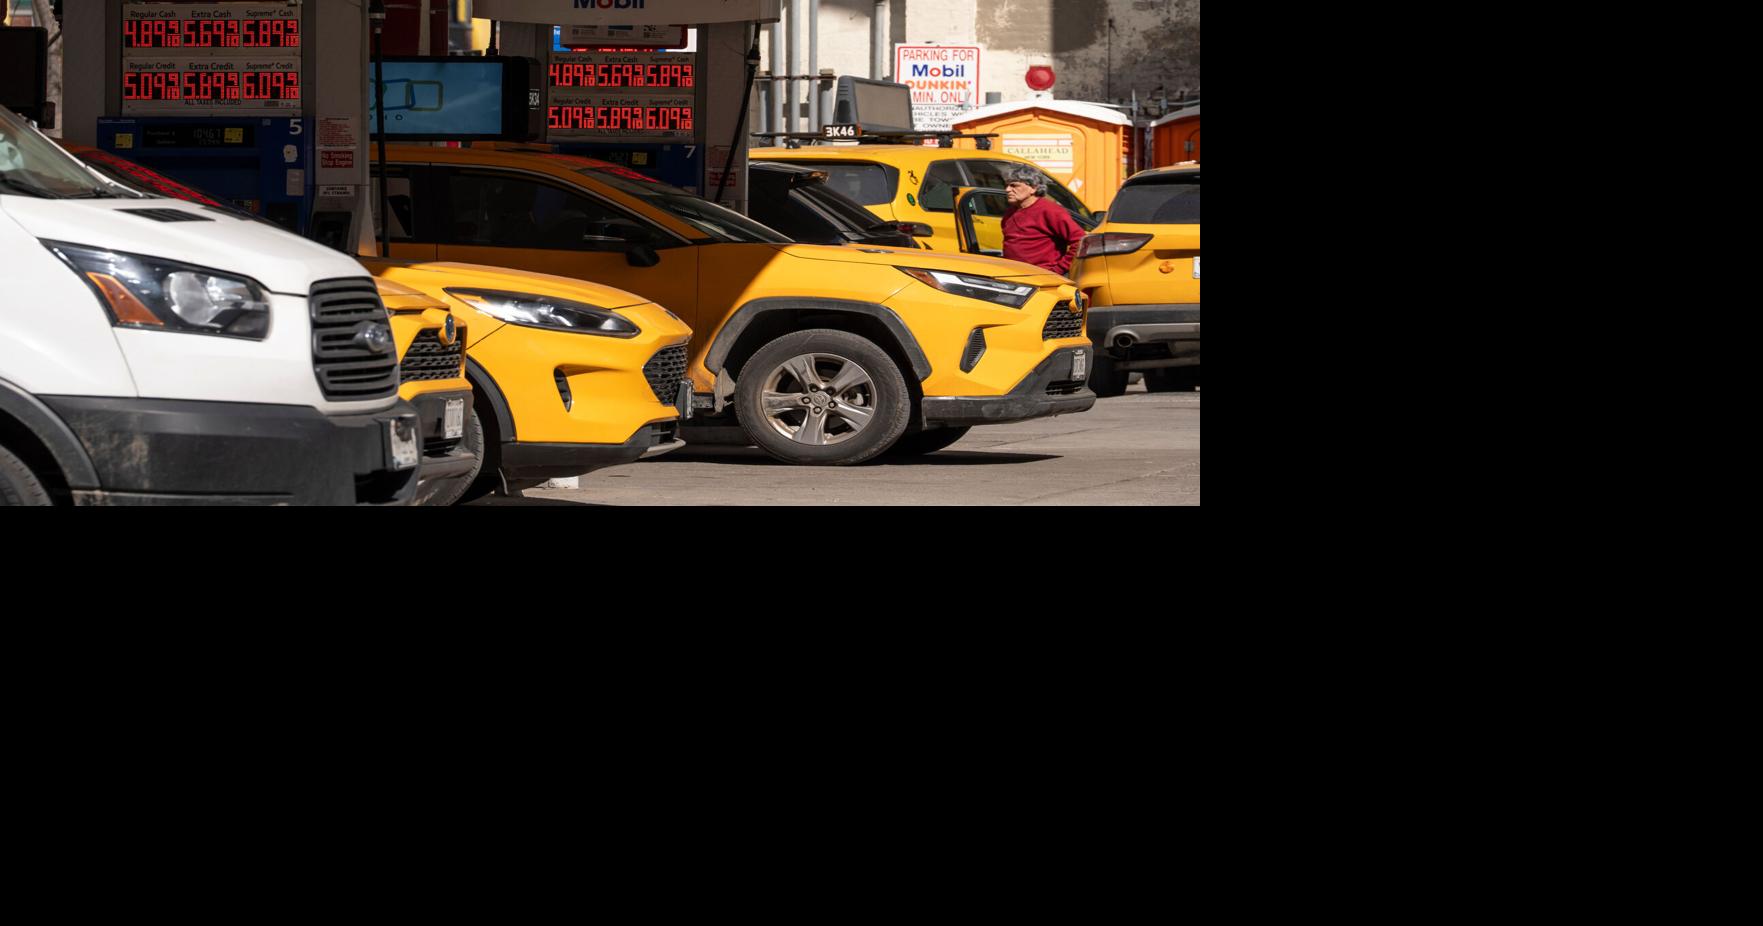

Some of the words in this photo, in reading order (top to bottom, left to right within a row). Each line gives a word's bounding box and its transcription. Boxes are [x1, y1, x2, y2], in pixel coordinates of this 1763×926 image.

[130, 10, 157, 19] Regular
[904, 50, 948, 61] PARKING
[953, 50, 974, 61] FOR
[129, 62, 155, 71] Regular
[912, 64, 964, 77] Mobil
[913, 92, 938, 103] MIN.
[289, 119, 302, 134] 5
[825, 126, 854, 137] 3K46
[684, 145, 696, 158] 7
